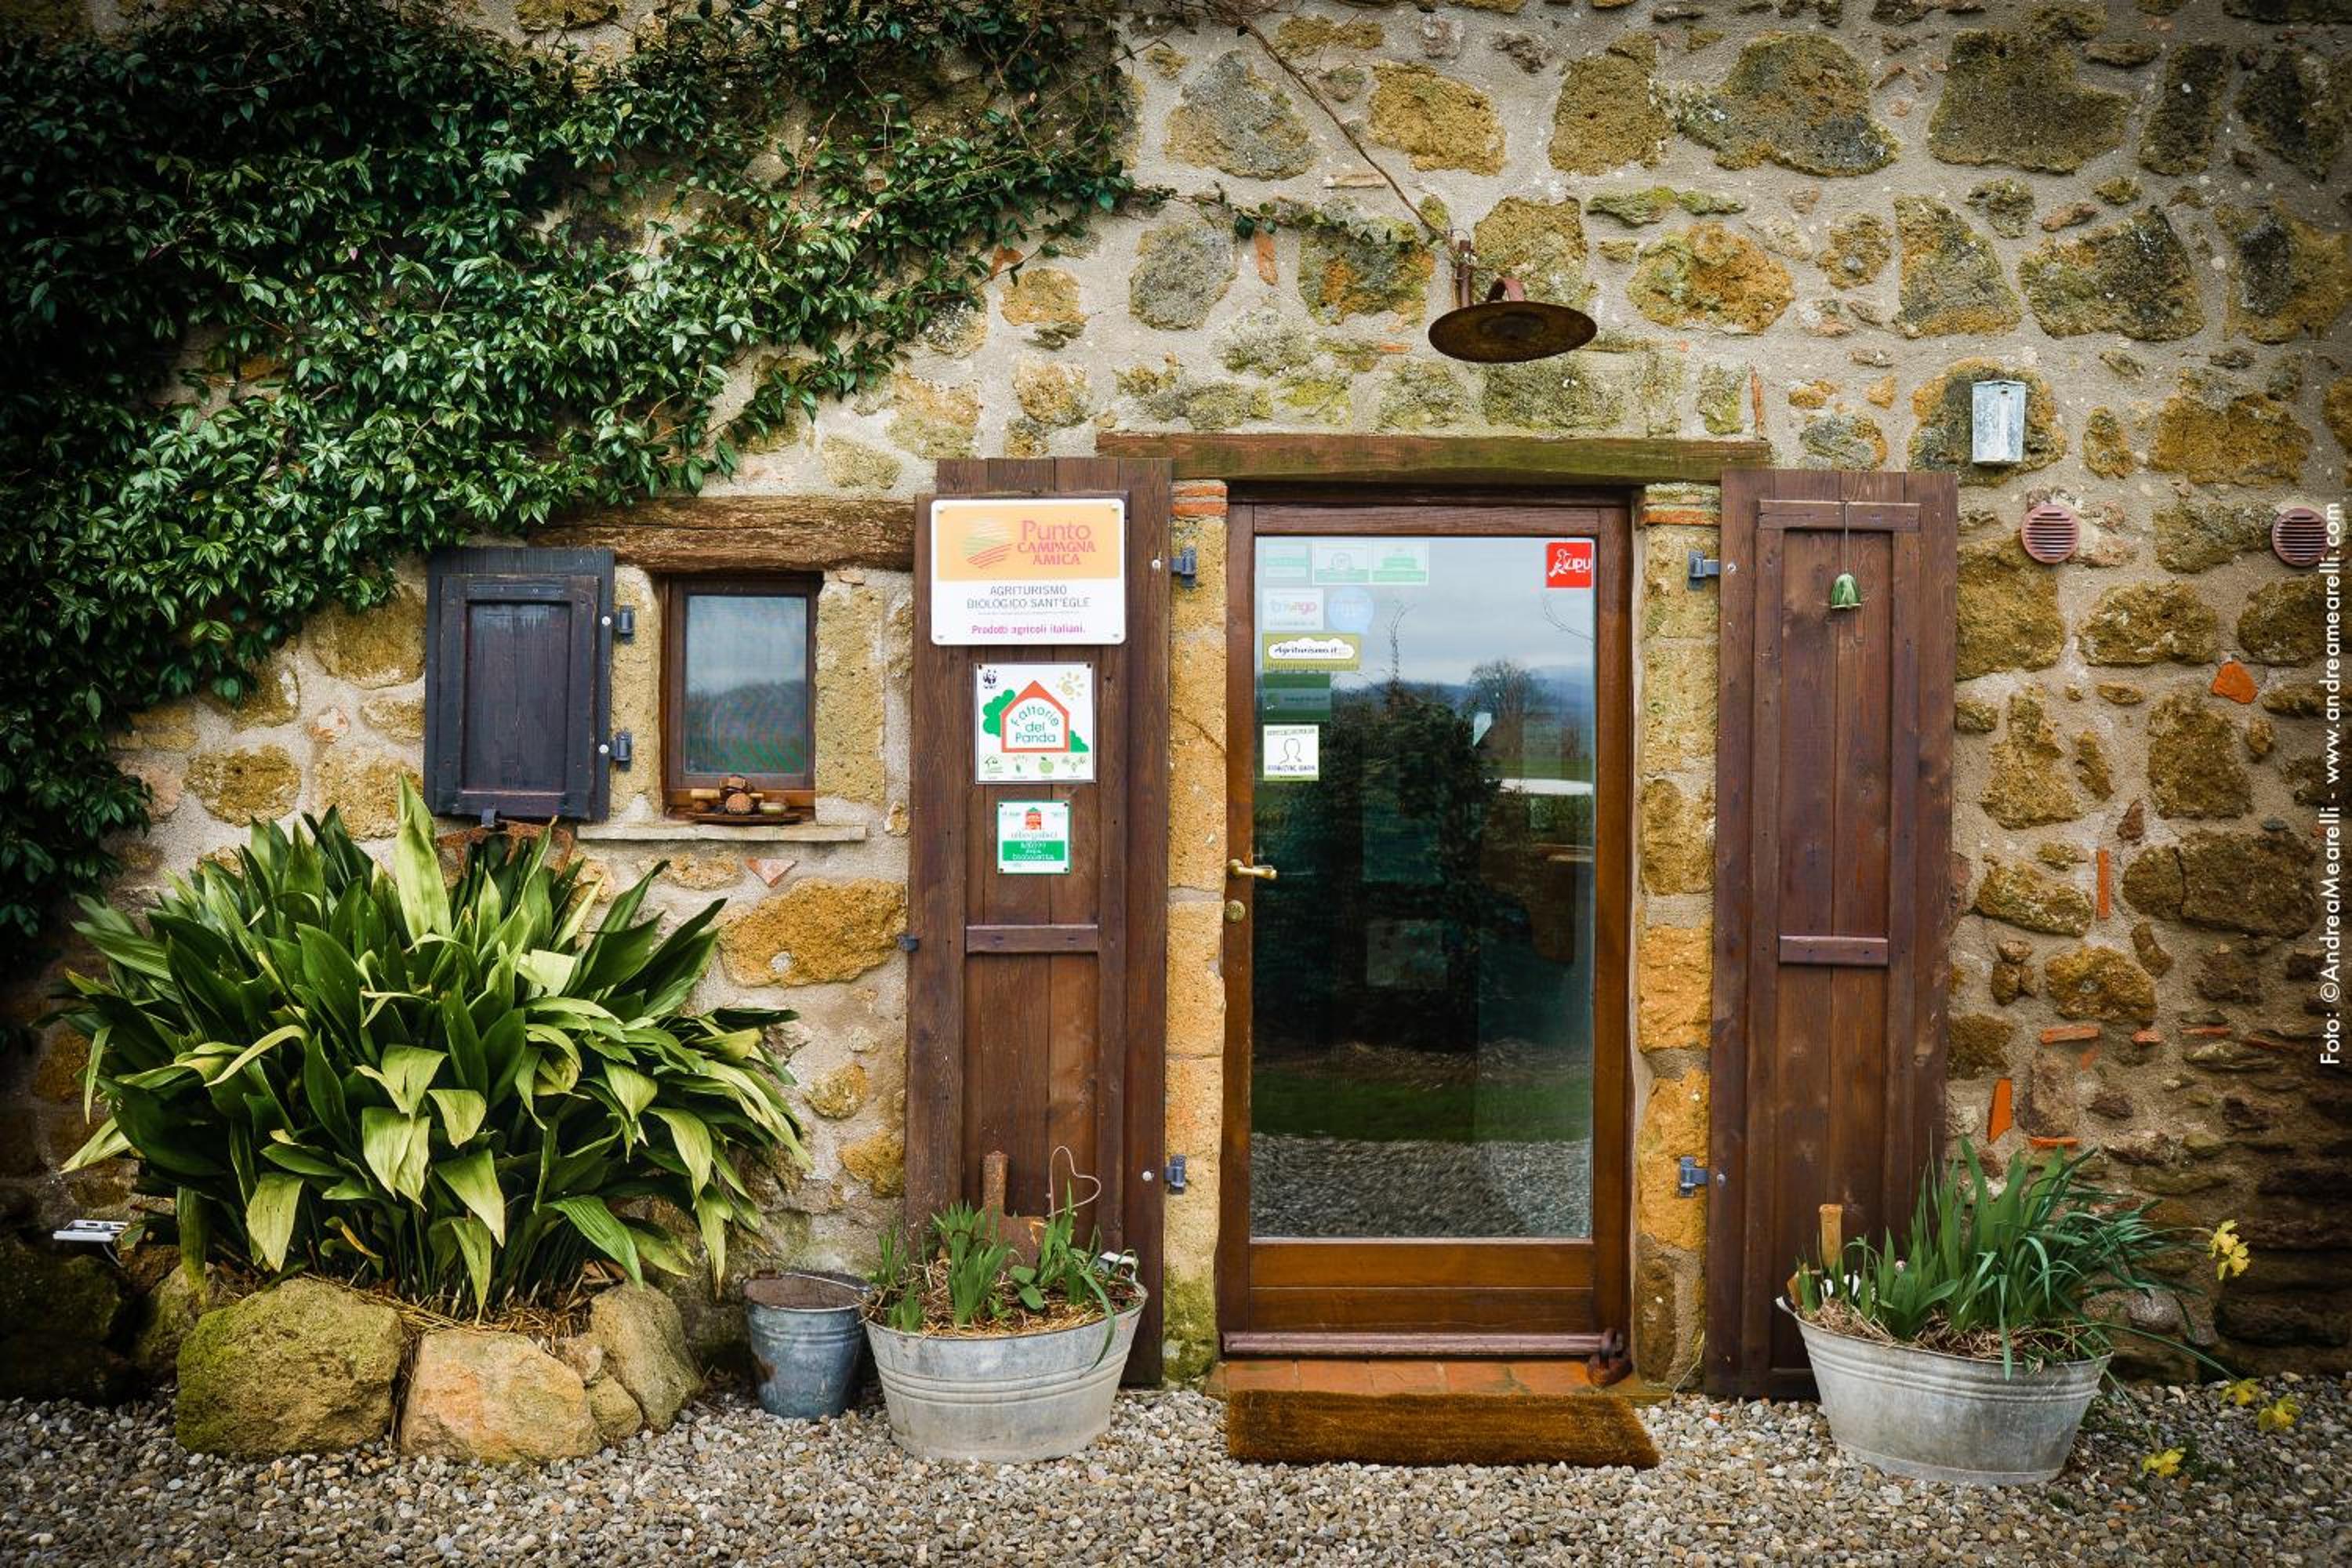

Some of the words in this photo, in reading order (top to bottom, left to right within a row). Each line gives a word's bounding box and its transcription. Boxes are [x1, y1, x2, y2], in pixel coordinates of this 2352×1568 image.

[1022, 520, 1092, 540] Punto
[1017, 541, 1096, 553] CAMPAGNA
[1032, 554, 1080, 565] AMICA
[990, 585, 1067, 596] AGRITURISMO
[967, 598, 1026, 609] BIOLOGICO
[1030, 597, 1091, 608] SANT'EGLE
[1011, 625, 1047, 636] agricoli
[1025, 720, 1045, 733] del
[1015, 731, 1056, 742] Panda
